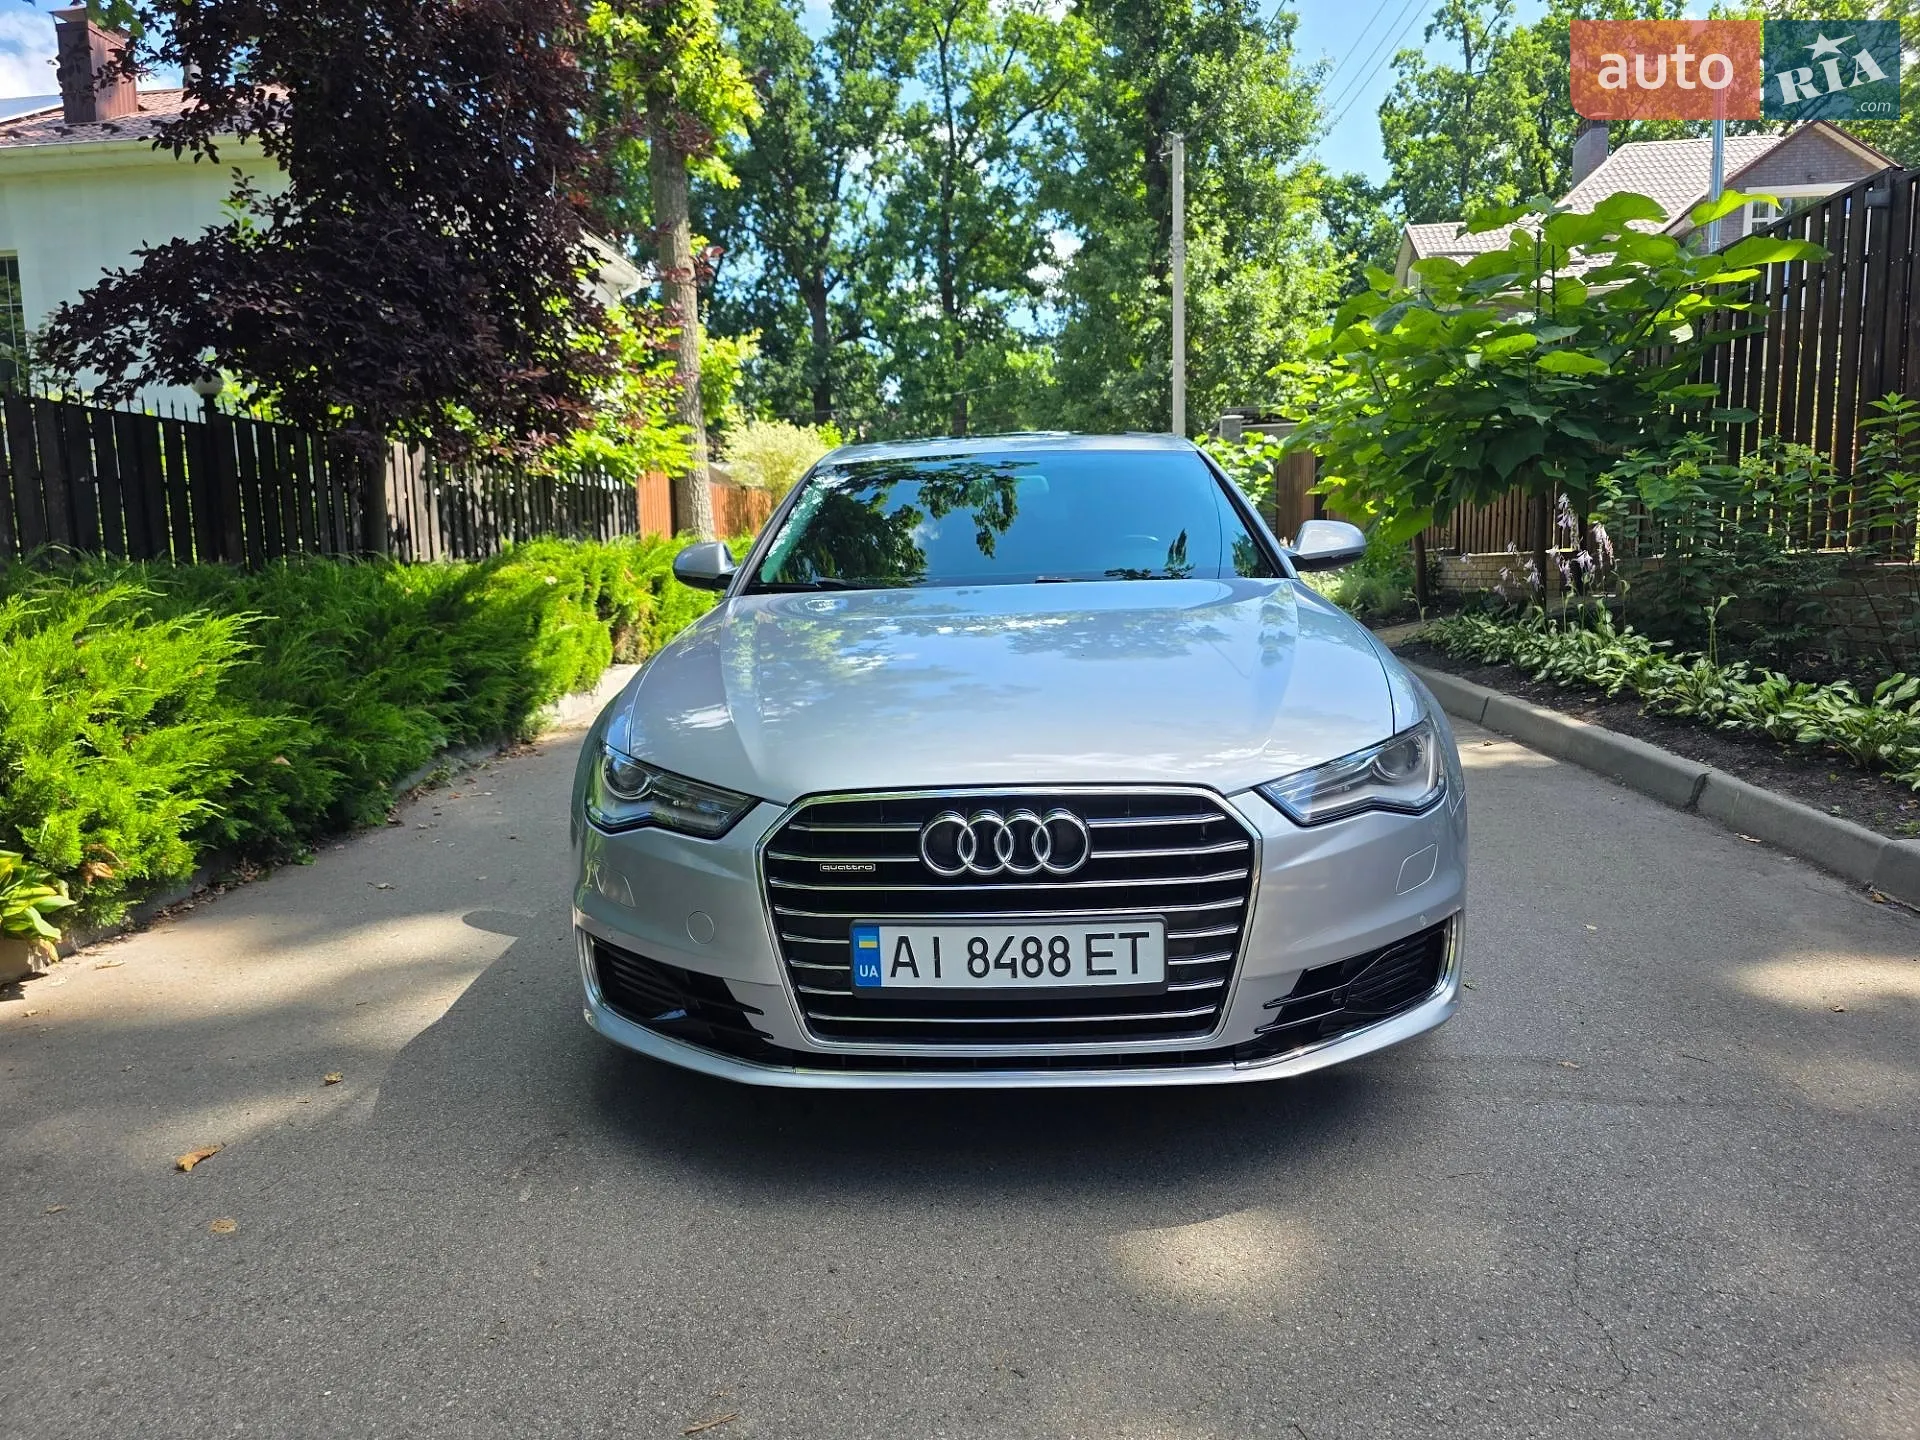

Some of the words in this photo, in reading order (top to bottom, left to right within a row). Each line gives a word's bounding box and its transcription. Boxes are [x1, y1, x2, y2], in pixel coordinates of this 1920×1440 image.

[821, 863, 873, 871] quattro
[890, 936, 942, 978] AI
[967, 935, 1071, 979] 8488
[1086, 932, 1150, 977] ET
[860, 965, 879, 979] UA
